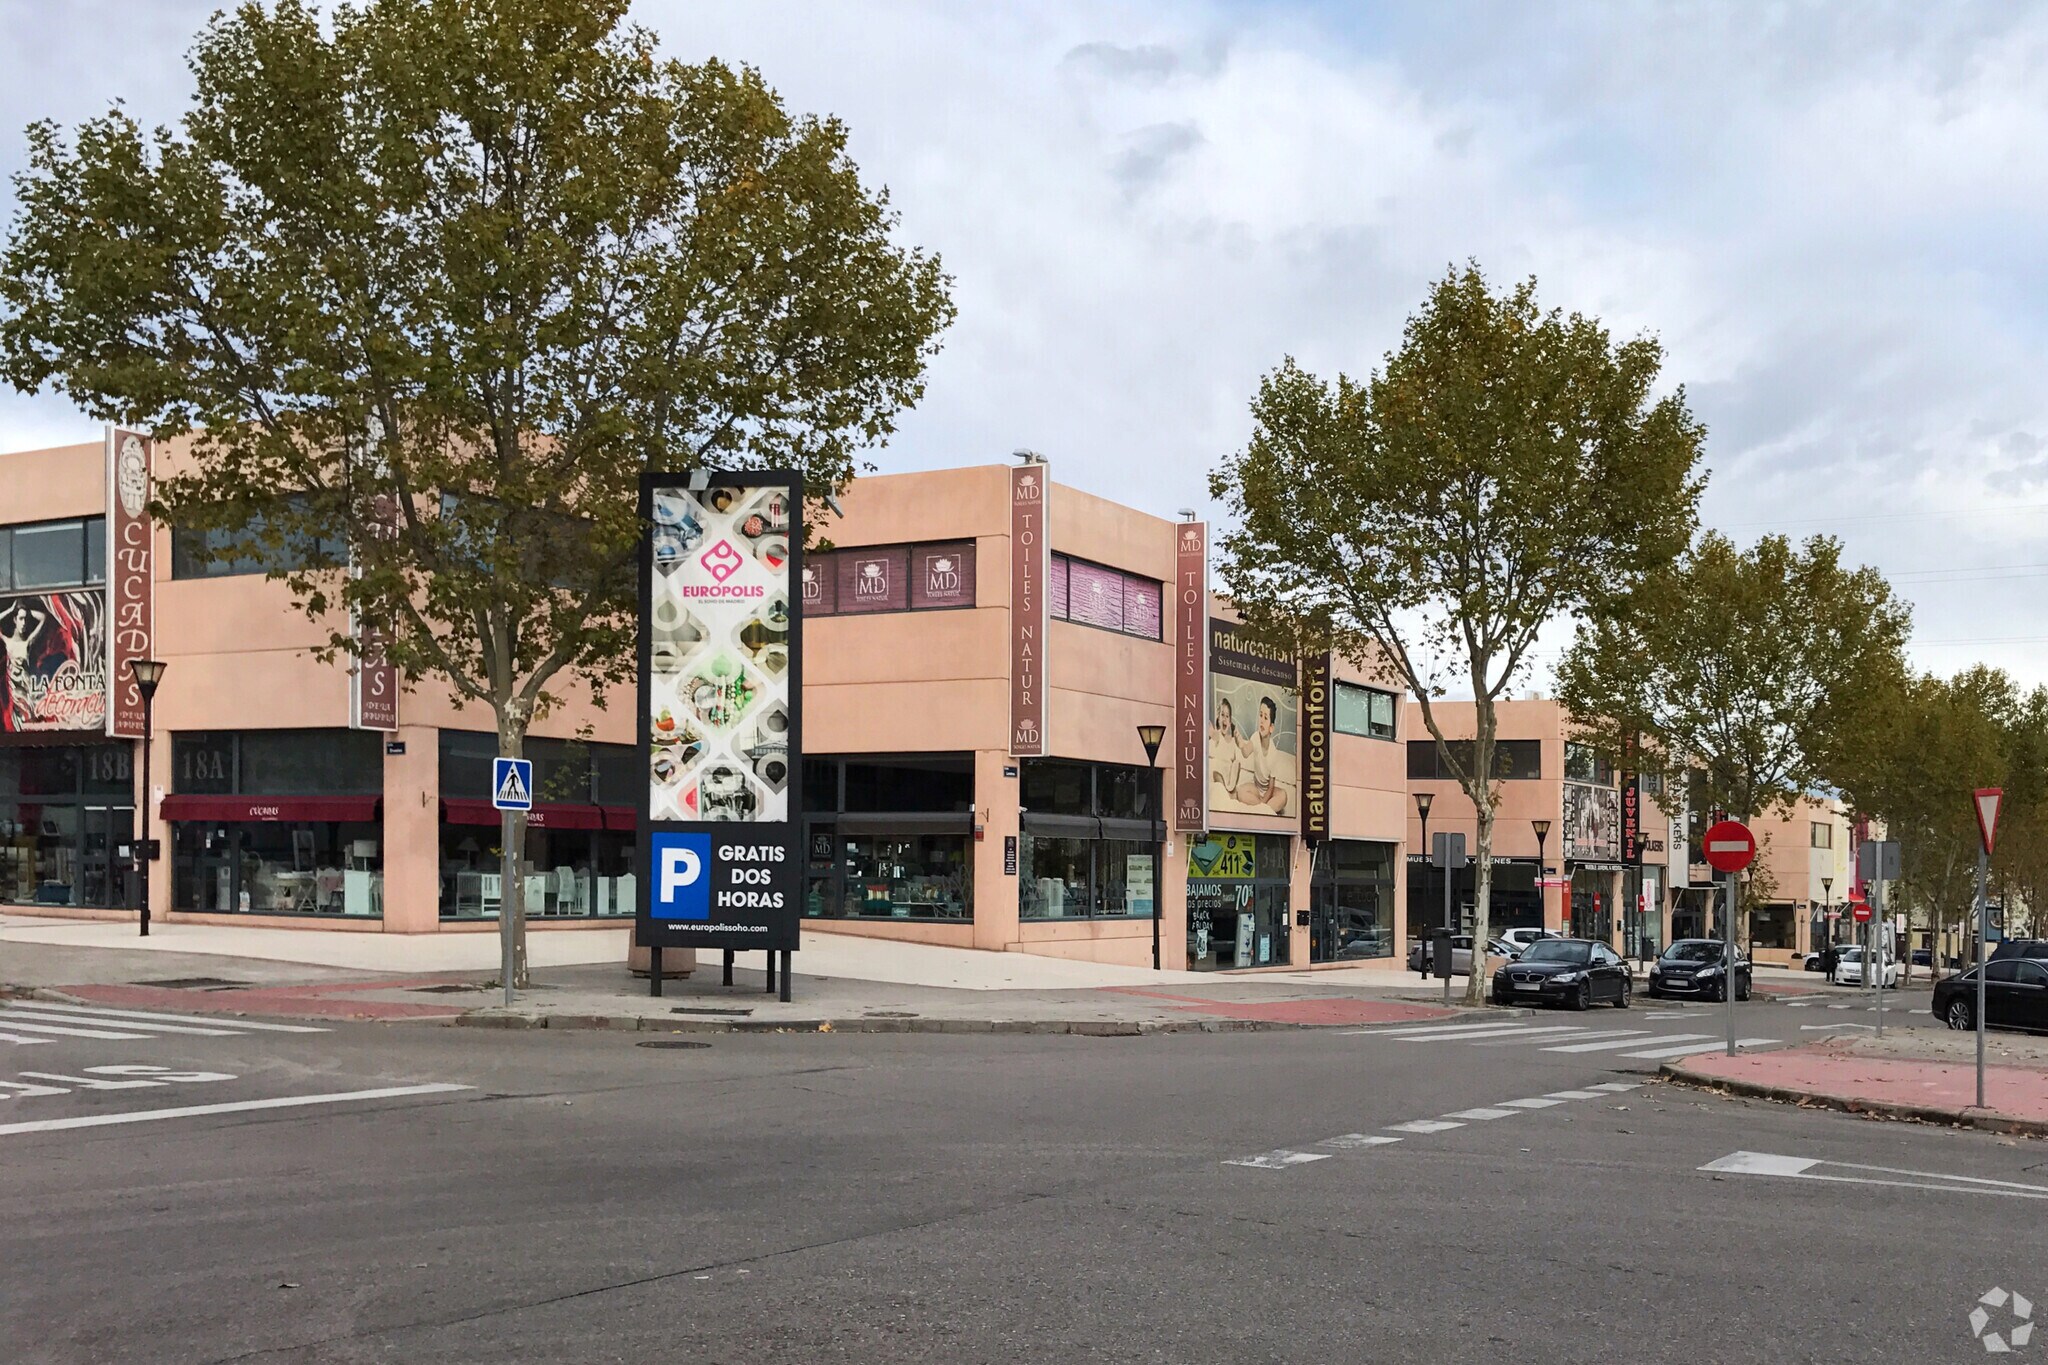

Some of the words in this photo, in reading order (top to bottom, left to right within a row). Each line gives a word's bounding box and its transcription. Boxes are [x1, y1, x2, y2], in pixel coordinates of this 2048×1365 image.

[1017, 485, 1040, 500] MD
[1181, 540, 1202, 552] MD
[1021, 514, 1034, 612] TOILES
[859, 576, 886, 595] MD
[930, 572, 958, 590] MD
[1184, 572, 1197, 675] TOILES
[1021, 626, 1034, 705] NATUR
[1218, 655, 1251, 672] Sistemas
[1251, 663, 1261, 674] de
[1261, 666, 1293, 680] descanso
[32, 675, 49, 692] LA
[1016, 729, 1039, 743] MD
[1184, 694, 1197, 780] NATUR
[1305, 666, 1325, 832] naturconfort
[90, 751, 129, 781] 18B
[184, 750, 225, 780] 18A
[1180, 808, 1201, 820] MD
[1625, 786, 1637, 859] JUVENIL
[1673, 806, 1683, 850] OLKERS
[718, 845, 786, 862] GRATIS
[814, 843, 831, 855] MD
[1472, 857, 1512, 865] JENES
[660, 847, 702, 903] P
[731, 868, 772, 885] DOS
[718, 891, 785, 908] HORAS
[1186, 884, 1222, 899] BAJAMOS
[1197, 900, 1222, 910] precios
[1192, 910, 1210, 921] BLACK
[668, 923, 769, 933] www.europolissoho.com
